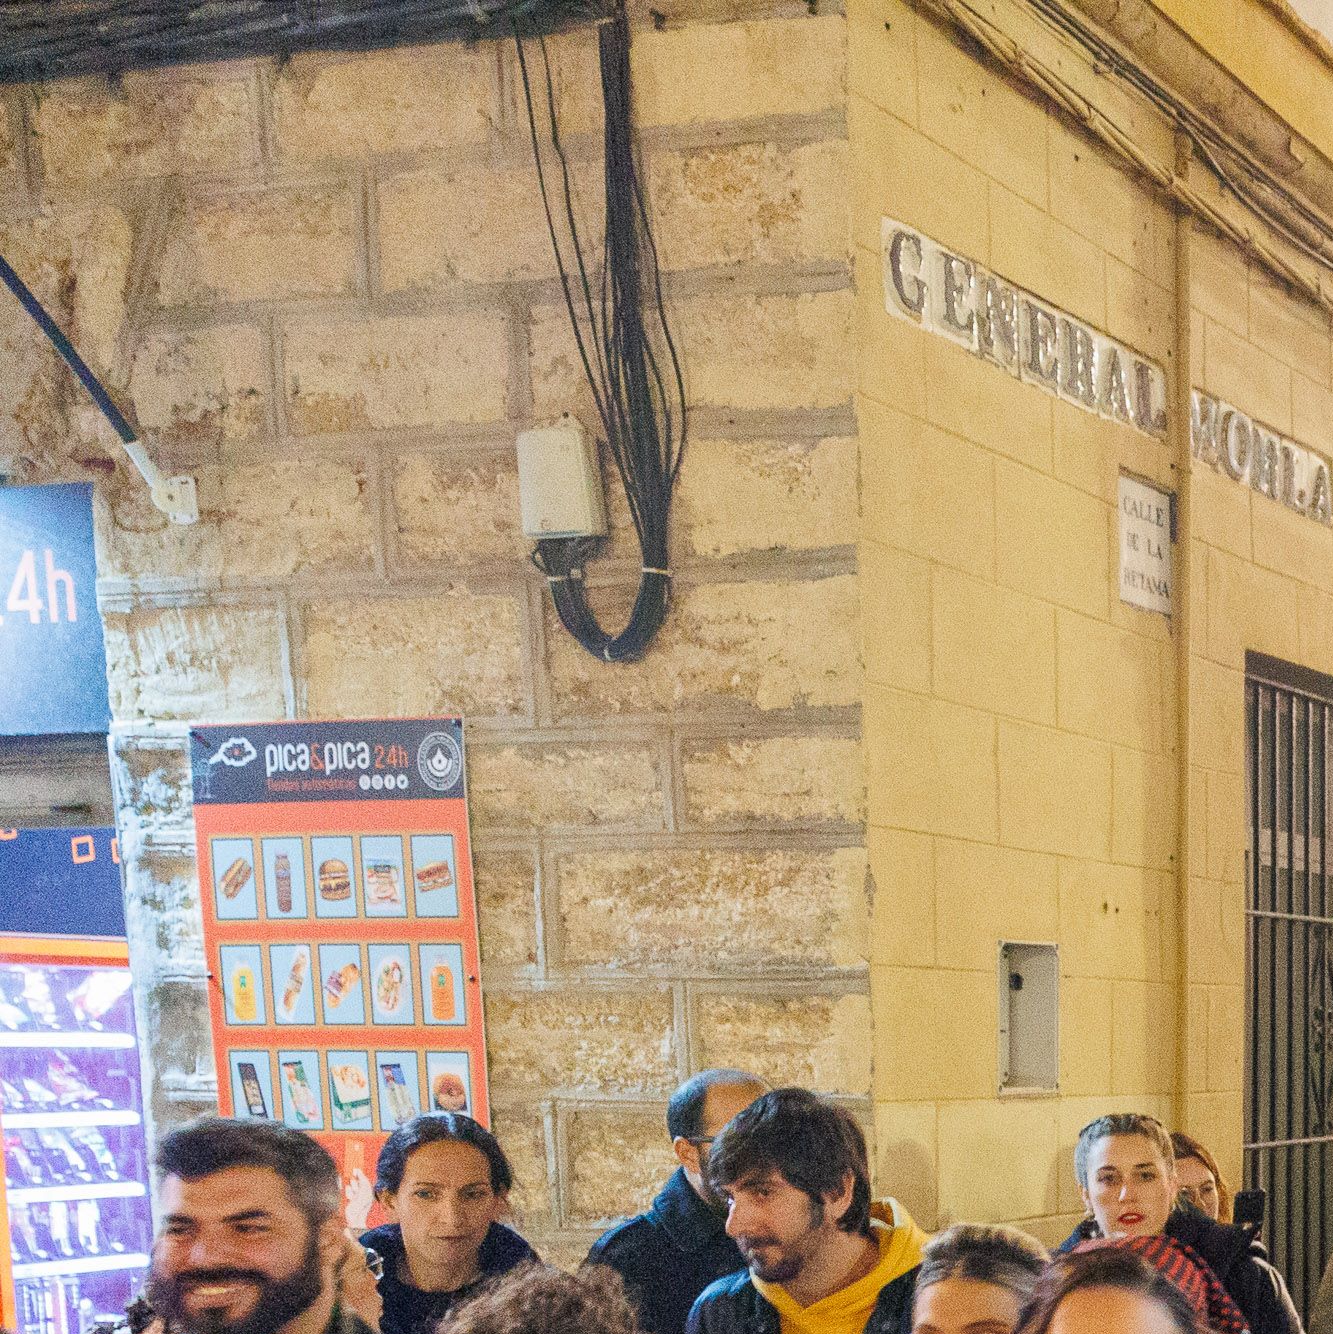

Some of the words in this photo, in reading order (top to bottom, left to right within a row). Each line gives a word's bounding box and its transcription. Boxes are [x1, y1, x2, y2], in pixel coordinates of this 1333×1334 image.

[889, 231, 1168, 437] GENERAL
[1123, 496, 1164, 527] CALLE
[1127, 532, 1139, 552] DE
[1147, 538, 1163, 561] LA
[0, 548, 77, 624] 4h
[1123, 567, 1170, 599] RETAMA
[265, 741, 371, 777] pica&pica
[375, 743, 410, 769] 24h
